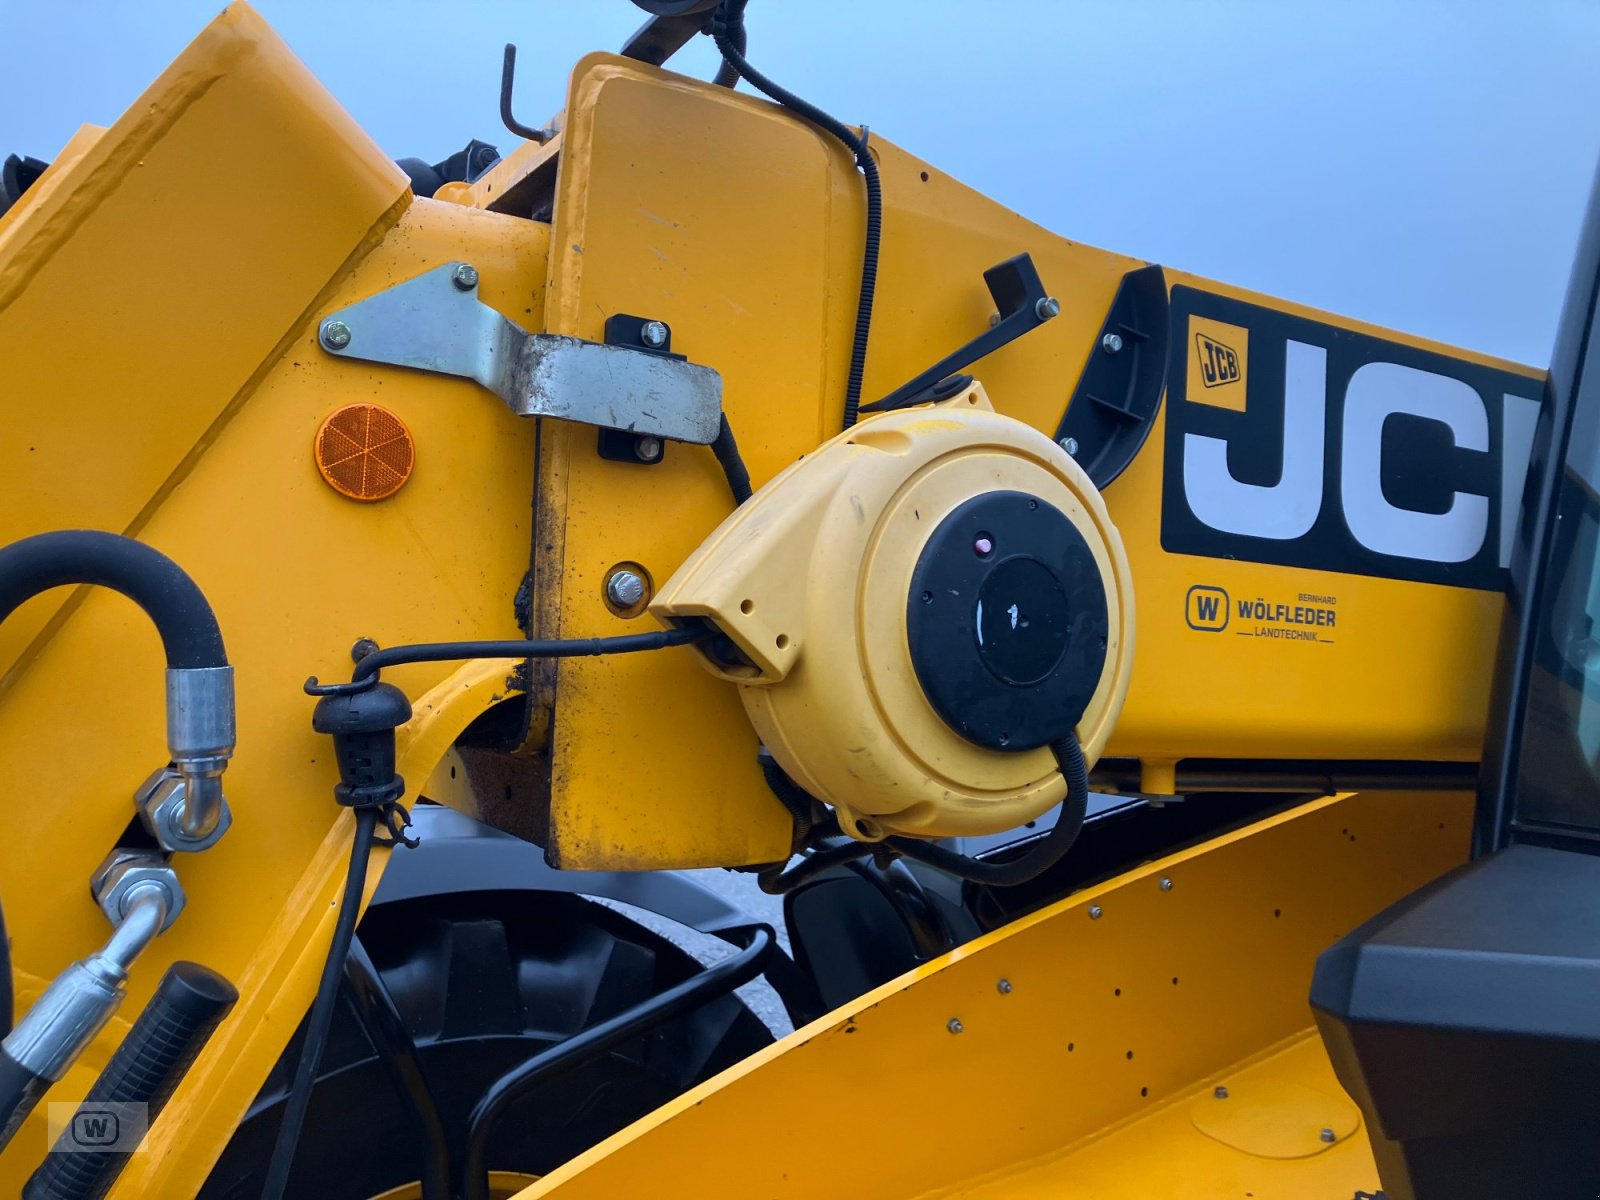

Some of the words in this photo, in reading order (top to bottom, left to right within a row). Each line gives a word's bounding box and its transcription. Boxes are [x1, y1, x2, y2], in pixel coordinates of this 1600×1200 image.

[1204, 340, 1238, 382] JCB
[1197, 595, 1219, 621] W
[1238, 597, 1336, 627] WÖLFLEDER
[1298, 593, 1337, 605] BERNHARD
[1254, 626, 1319, 642] LANDTECHNIK
